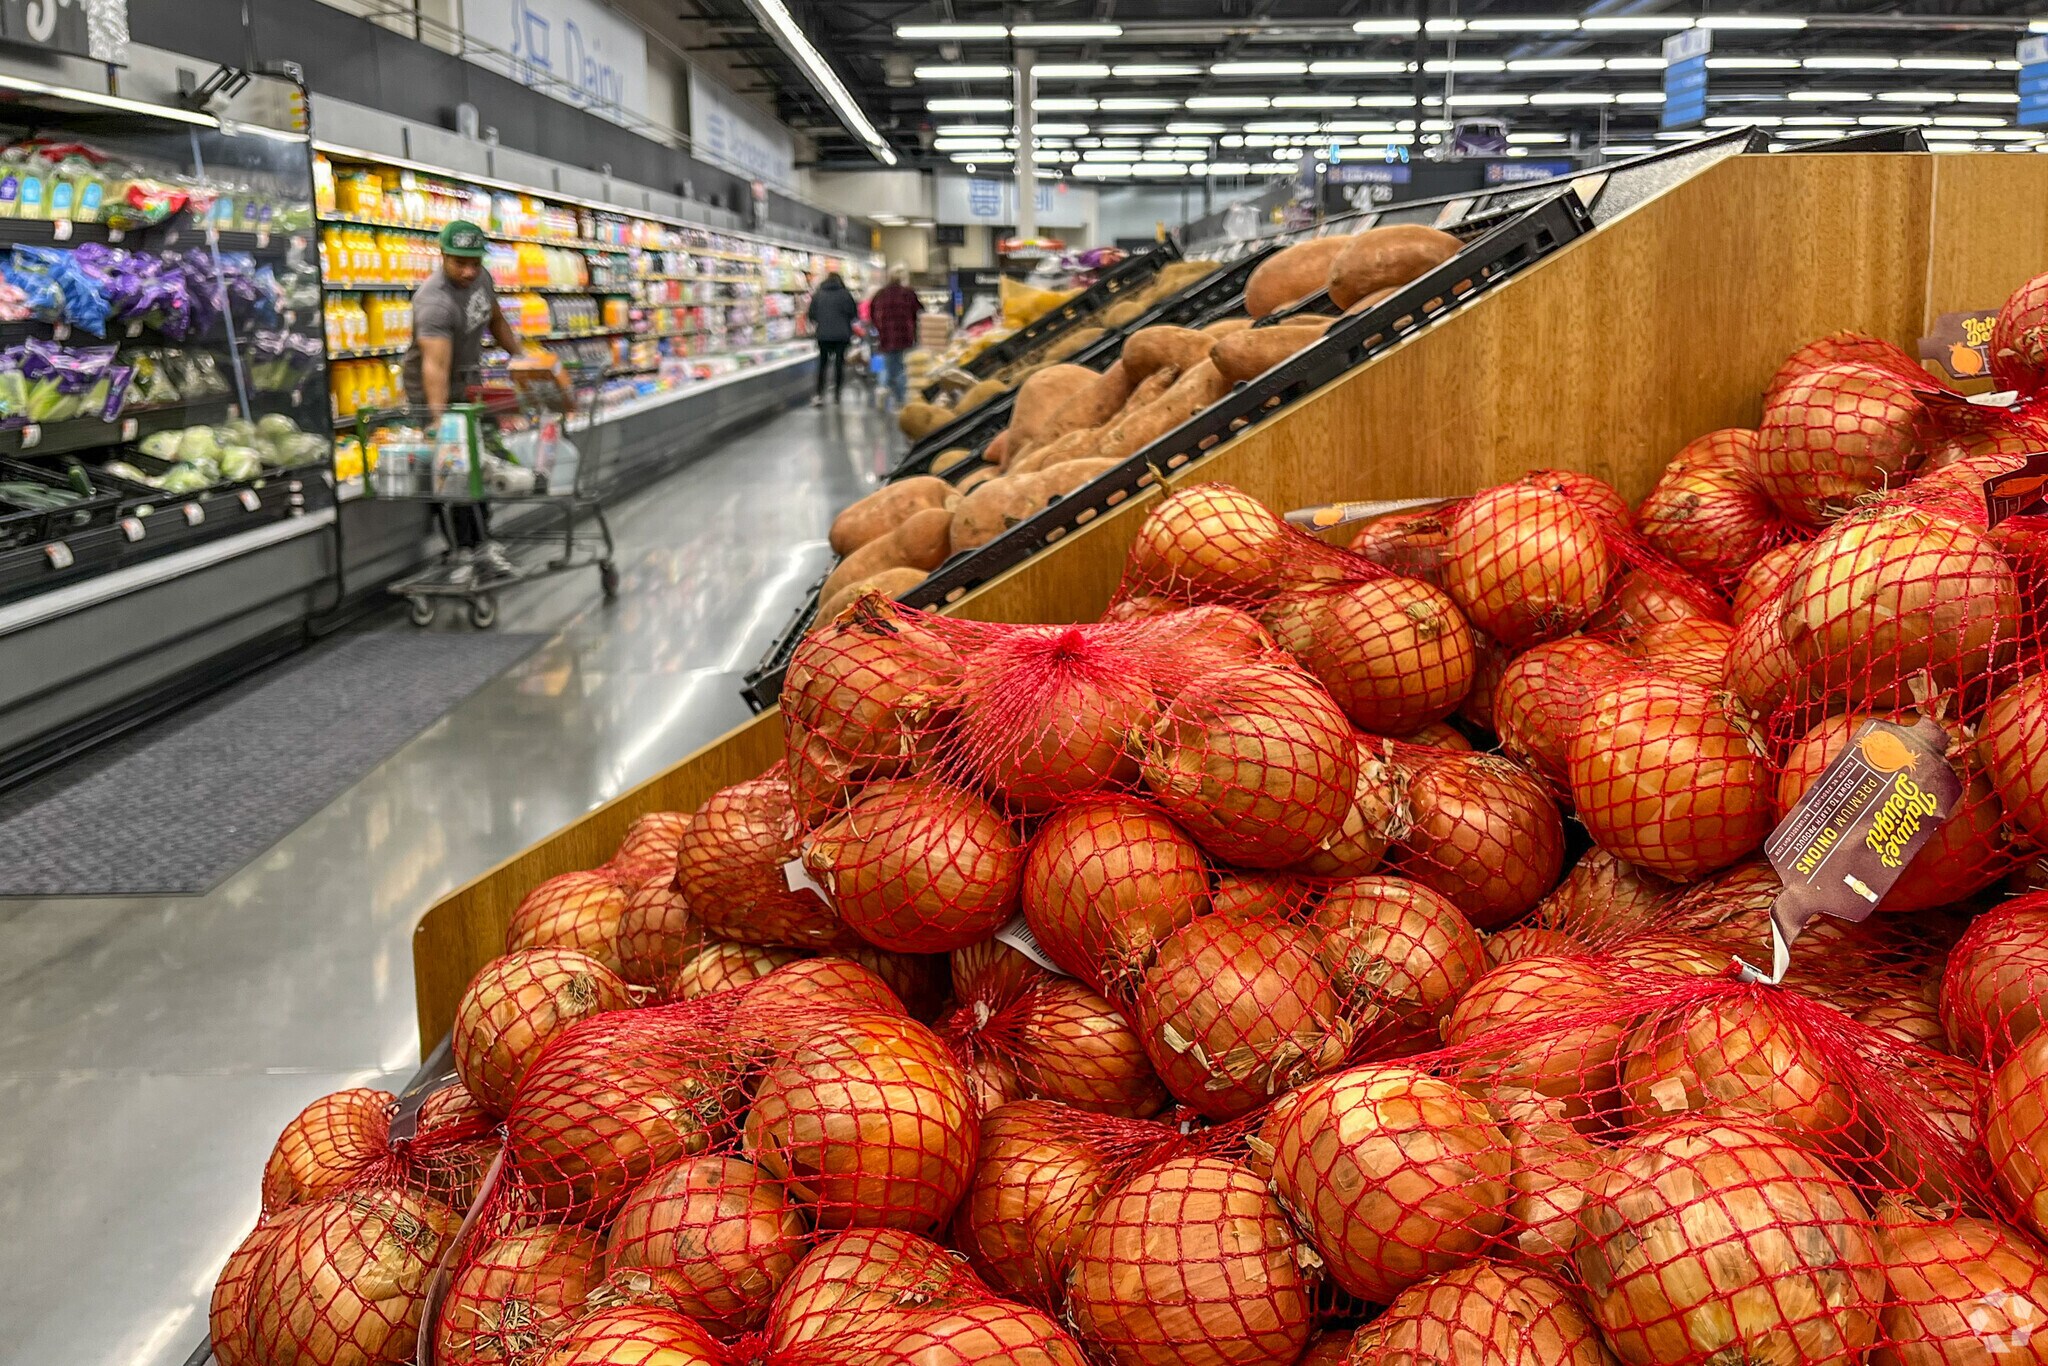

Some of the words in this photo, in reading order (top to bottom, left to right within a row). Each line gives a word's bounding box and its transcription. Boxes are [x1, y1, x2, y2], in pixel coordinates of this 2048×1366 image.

[564, 20, 624, 121] Dairy
[1829, 797, 1840, 807] TO
[1833, 778, 1878, 828] PREMIUM
[1836, 779, 1854, 798] DOWN
[1814, 806, 1832, 826] EARTH
[1865, 772, 1920, 854] Delight
[1879, 790, 1937, 868] Nature's
[1792, 826, 1818, 853] PRODUCE
[1795, 827, 1839, 875] ONIONS
